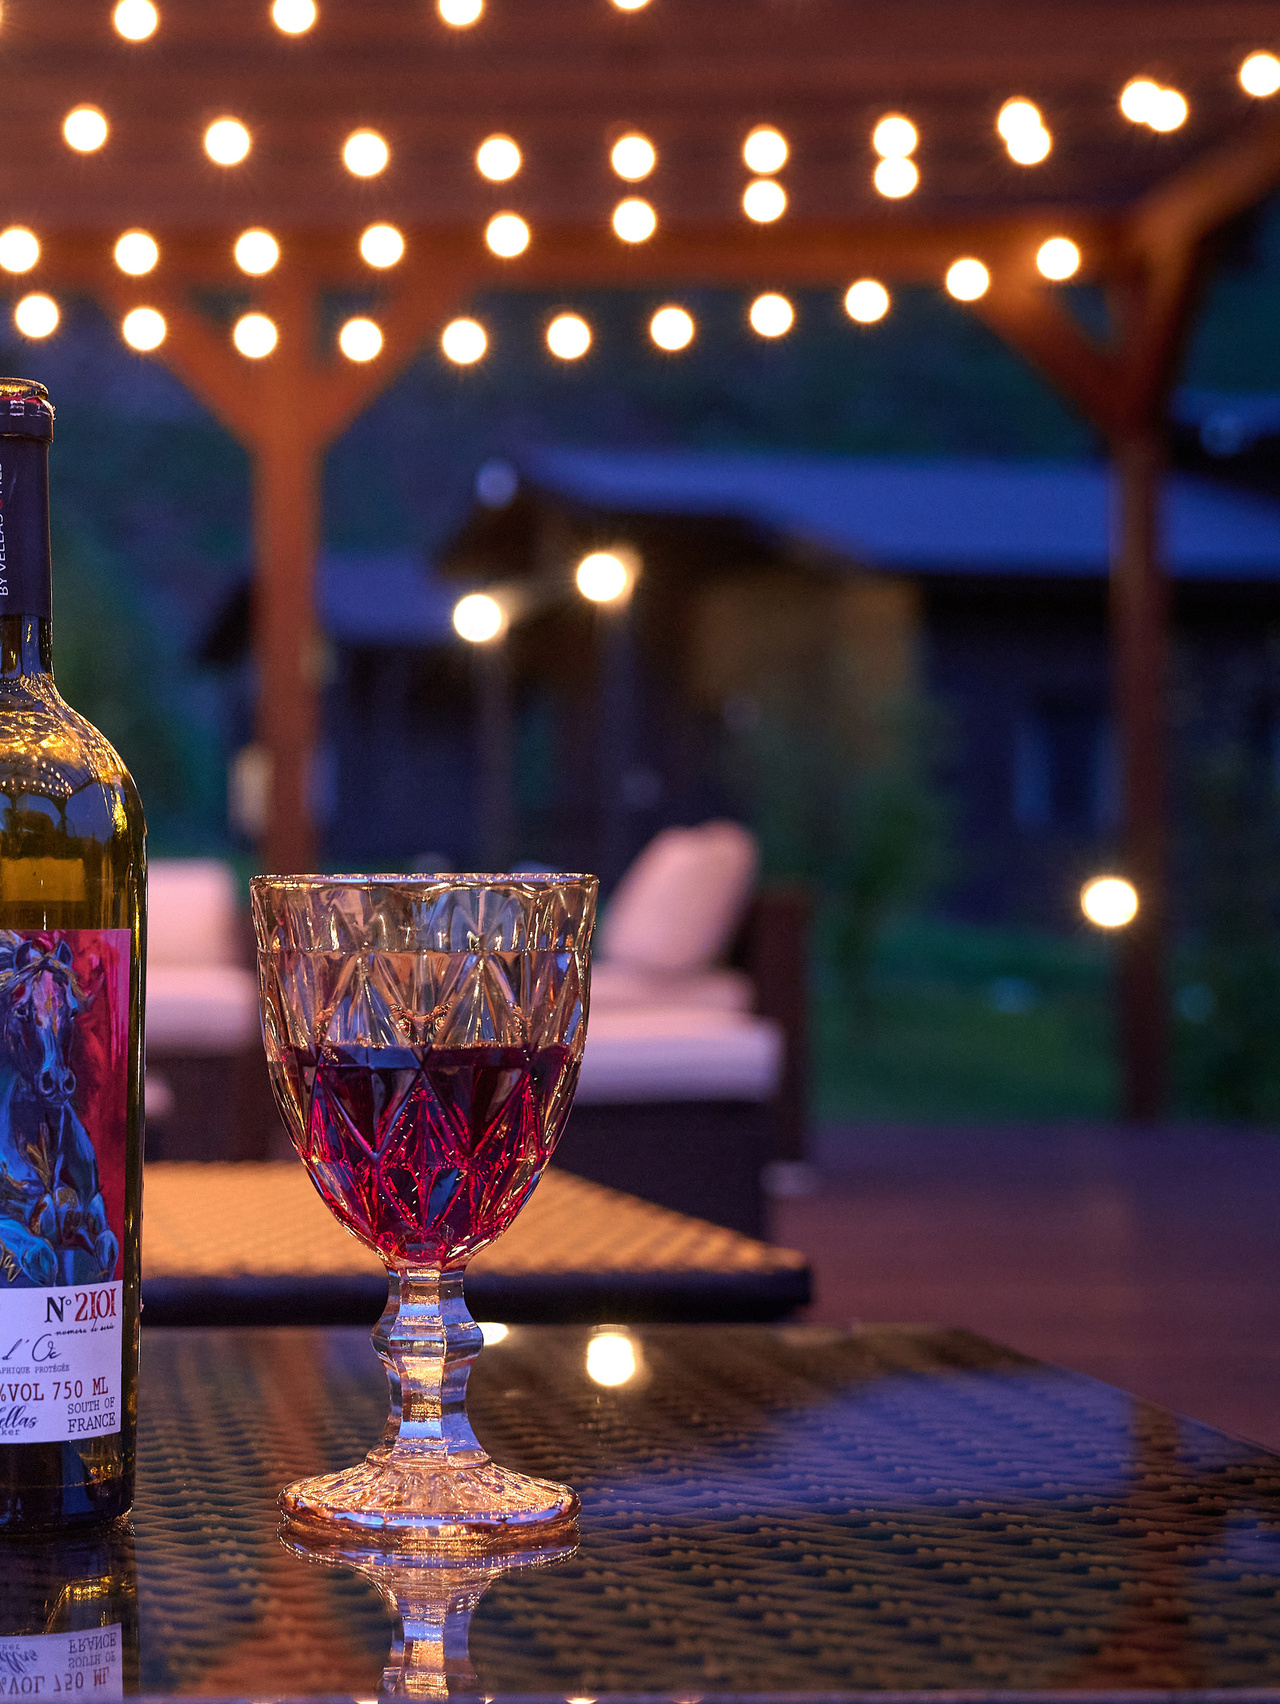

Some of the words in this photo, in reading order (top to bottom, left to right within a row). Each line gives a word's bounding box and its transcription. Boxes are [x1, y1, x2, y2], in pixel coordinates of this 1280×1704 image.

[75, 1288, 117, 1322] 2101
[34, 1363, 70, 1374] PROTÉGÉE
[52, 1380, 83, 1400] 750
[92, 1376, 109, 1396] ML
[67, 1399, 100, 1415] SOUTH
[104, 1396, 116, 1409] OF
[67, 1411, 116, 1433] FRANCE
